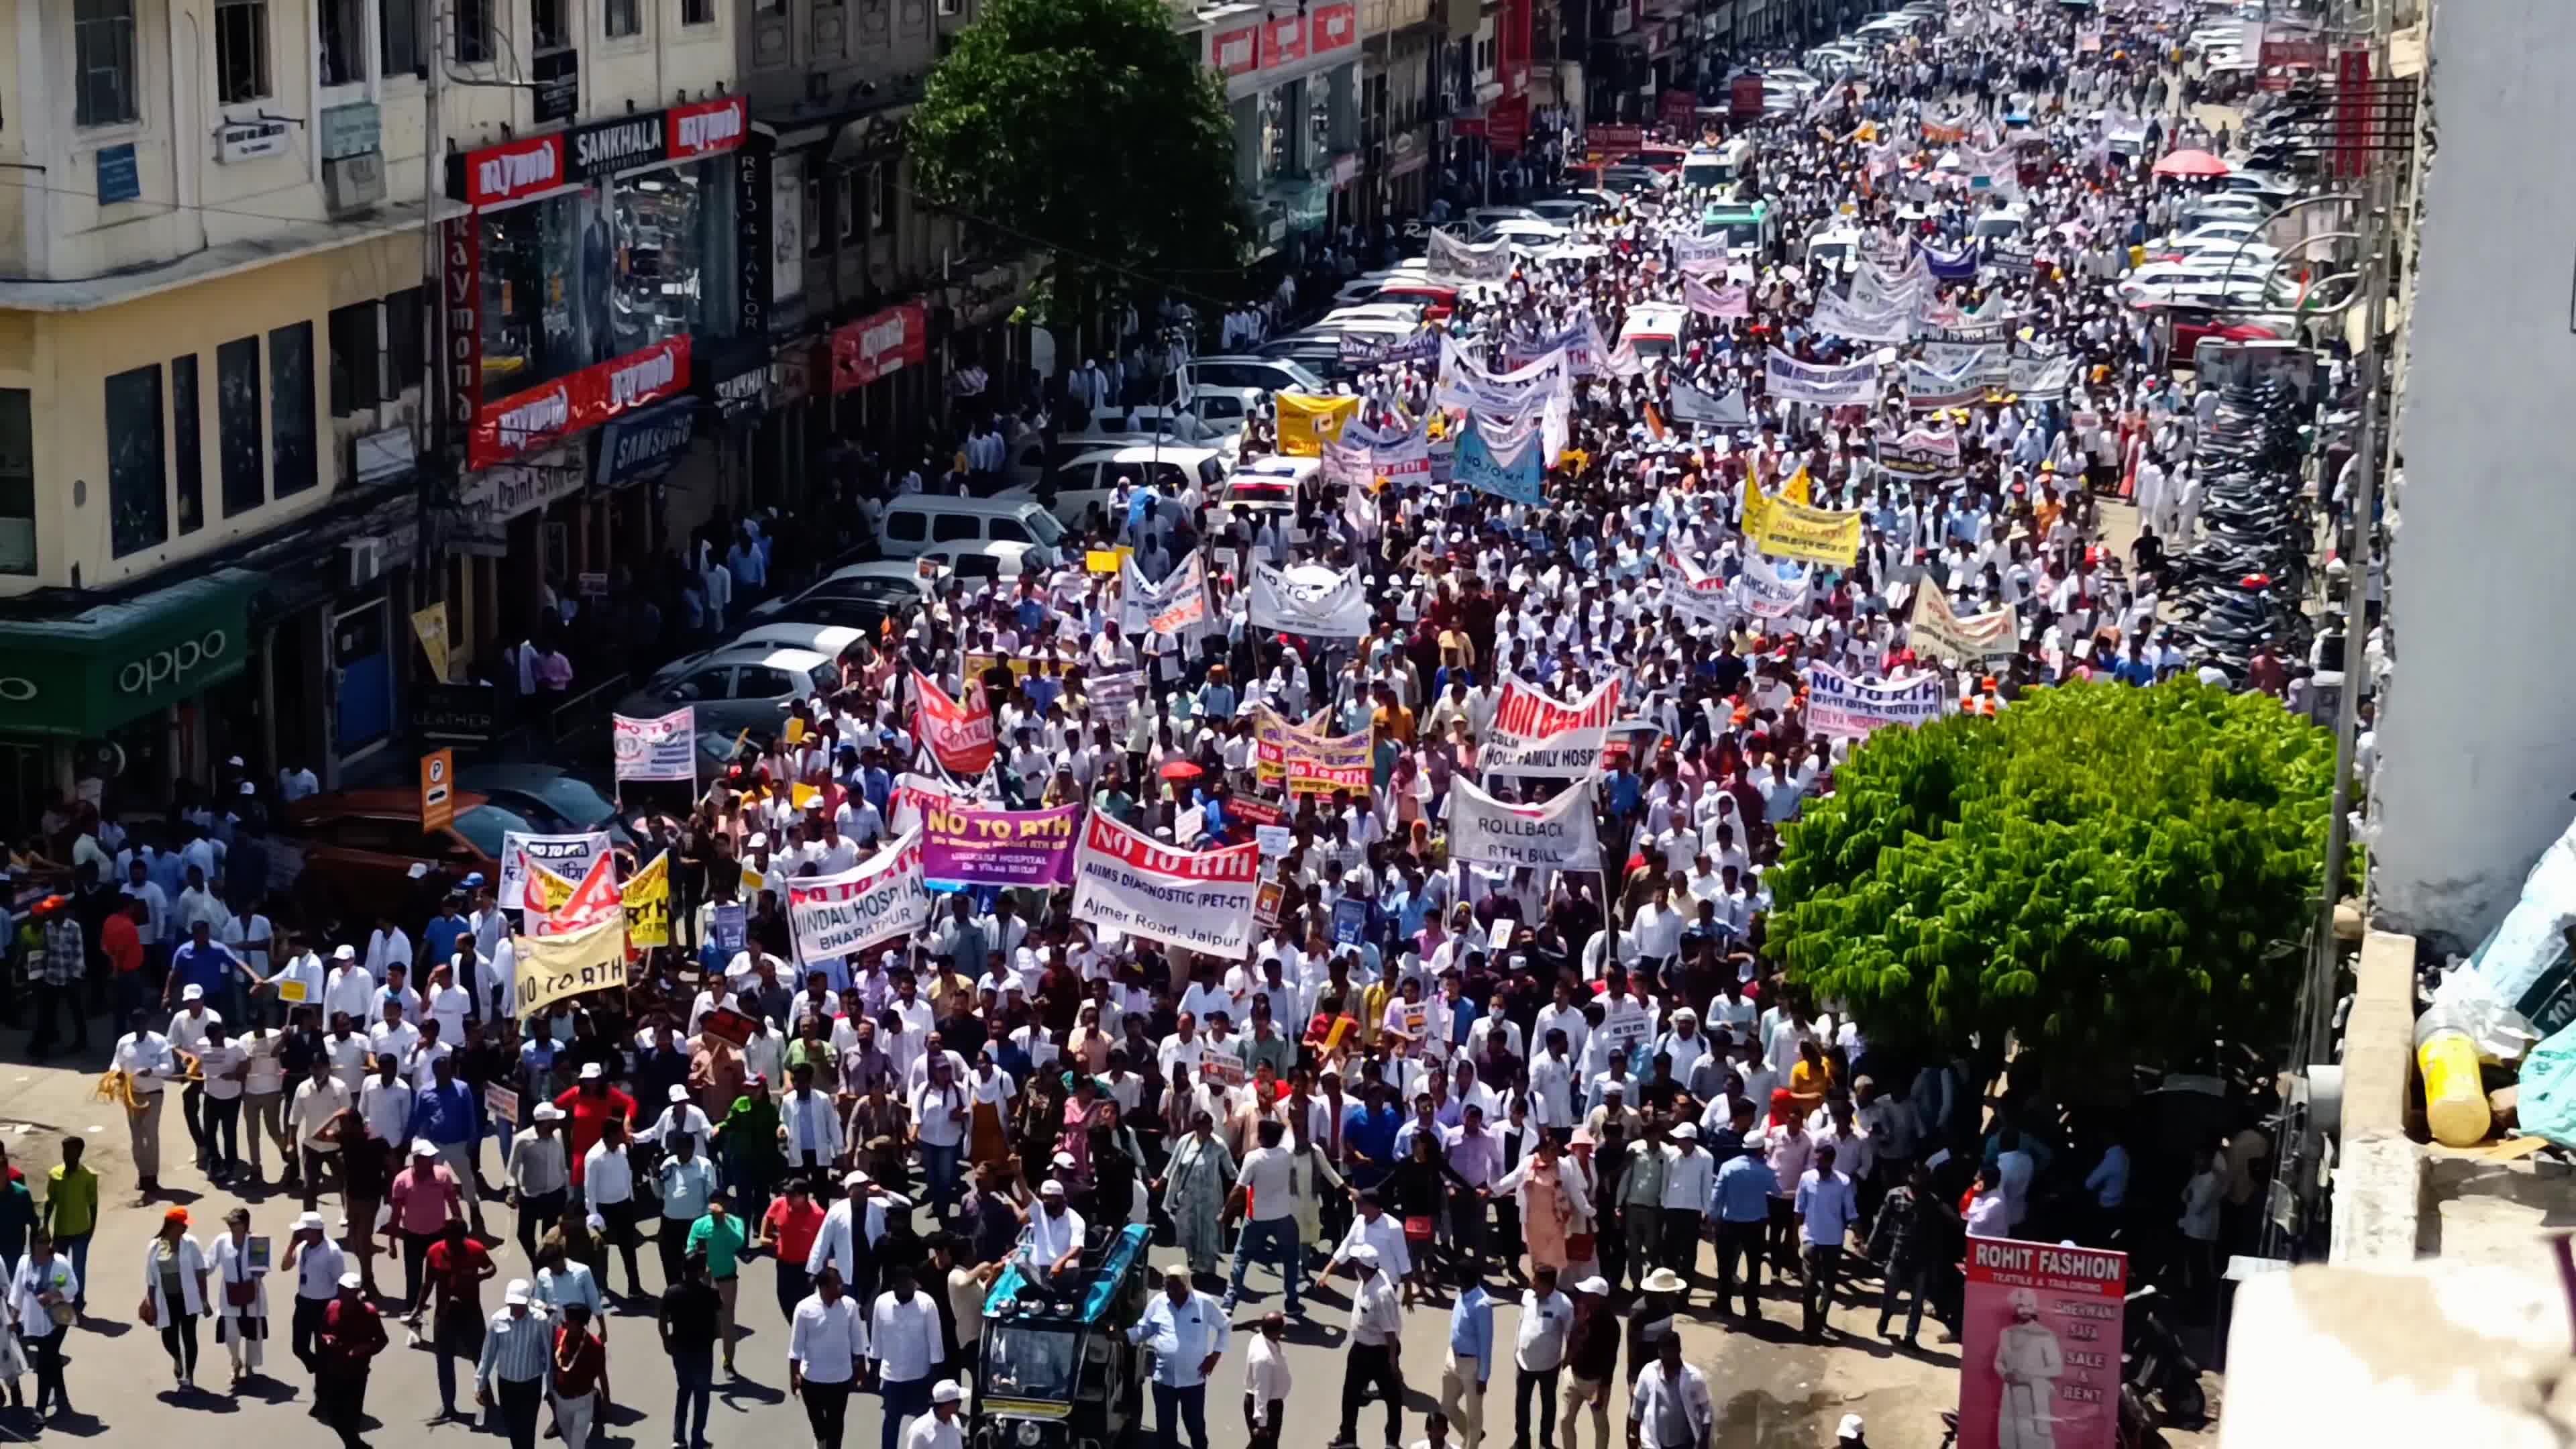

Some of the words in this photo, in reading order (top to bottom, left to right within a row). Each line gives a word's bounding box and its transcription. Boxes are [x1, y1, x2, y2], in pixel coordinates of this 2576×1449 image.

[578, 119, 662, 167] SANKHALA
[616, 412, 694, 470] SAMSUNG
[498, 470, 535, 508] Paint
[1813, 672, 1844, 694] NO
[1494, 682, 1541, 737] Roll
[928, 809, 967, 836] NO
[973, 818, 1012, 839] TO
[1019, 813, 1072, 838] RTH
[1095, 822, 1132, 857] NO
[1144, 847, 1181, 871] TO
[1190, 851, 1250, 876] RTH
[1487, 843, 1525, 863] RTH
[1527, 847, 1564, 863] BILL
[790, 886, 827, 906] NO
[839, 876, 873, 900] TO
[1121, 873, 1194, 904] DIAGNOSTIC
[1198, 892, 1251, 911] (PET-CT)
[794, 906, 851, 937] JINDAL
[1083, 897, 1130, 920] Ajmer
[1135, 913, 1182, 938] Road,
[1187, 928, 1241, 948] Jaipur
[518, 975, 537, 1010] NO
[547, 973, 576, 994] TO
[581, 955, 623, 985] RTH
[1976, 1243, 2034, 1271] ROHIT
[2039, 1250, 2121, 1281] FASHION
[2066, 1353, 2105, 1368] SALE
[2063, 1386, 2102, 1403] RENT
